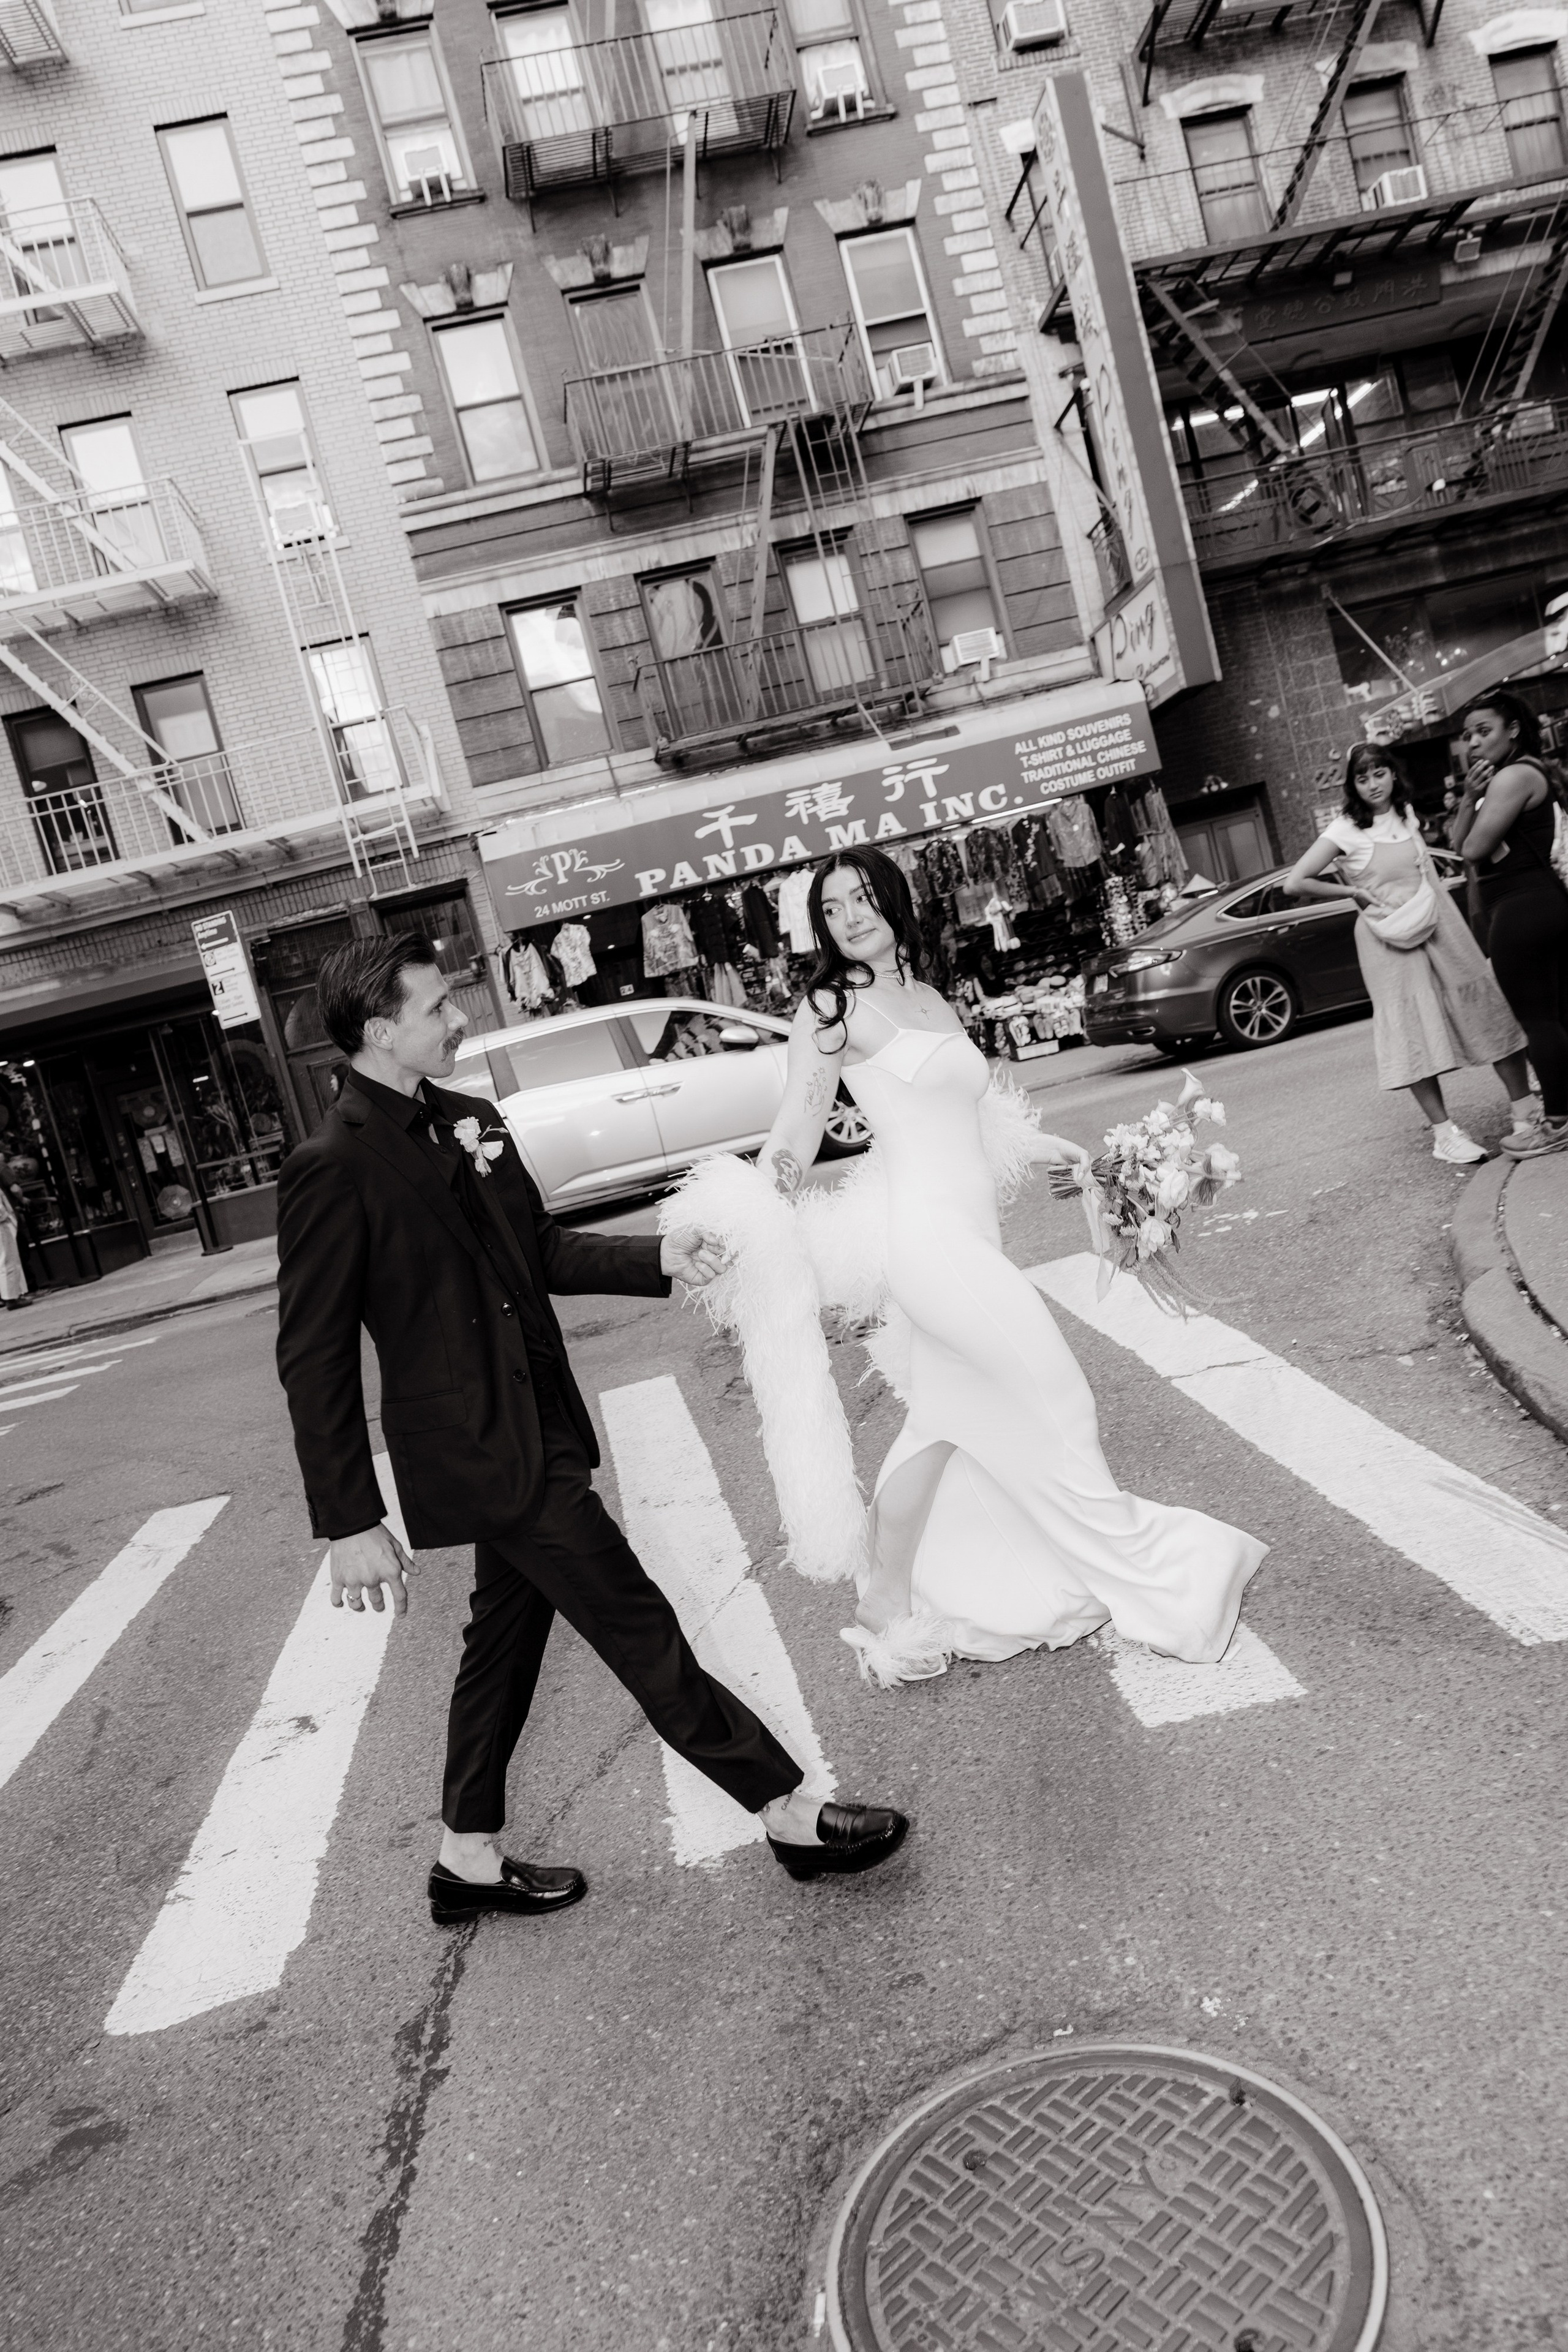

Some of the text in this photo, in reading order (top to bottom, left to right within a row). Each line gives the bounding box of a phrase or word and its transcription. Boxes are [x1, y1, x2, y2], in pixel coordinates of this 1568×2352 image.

[1014, 713, 1132, 755] ALL KIND SOUVENIRS
[1020, 728, 1133, 768] T-SHIRT & LUGGAGE
[1020, 740, 1147, 784] TRADITIONAL CHINESE
[1040, 758, 1136, 795] COSTUME OUTFIT
[694, 758, 950, 849] 千禧行
[635, 783, 1023, 897] PANDA MA INC.
[534, 891, 611, 918] 24 MOTT ST.
[214, 982, 222, 995] 2
